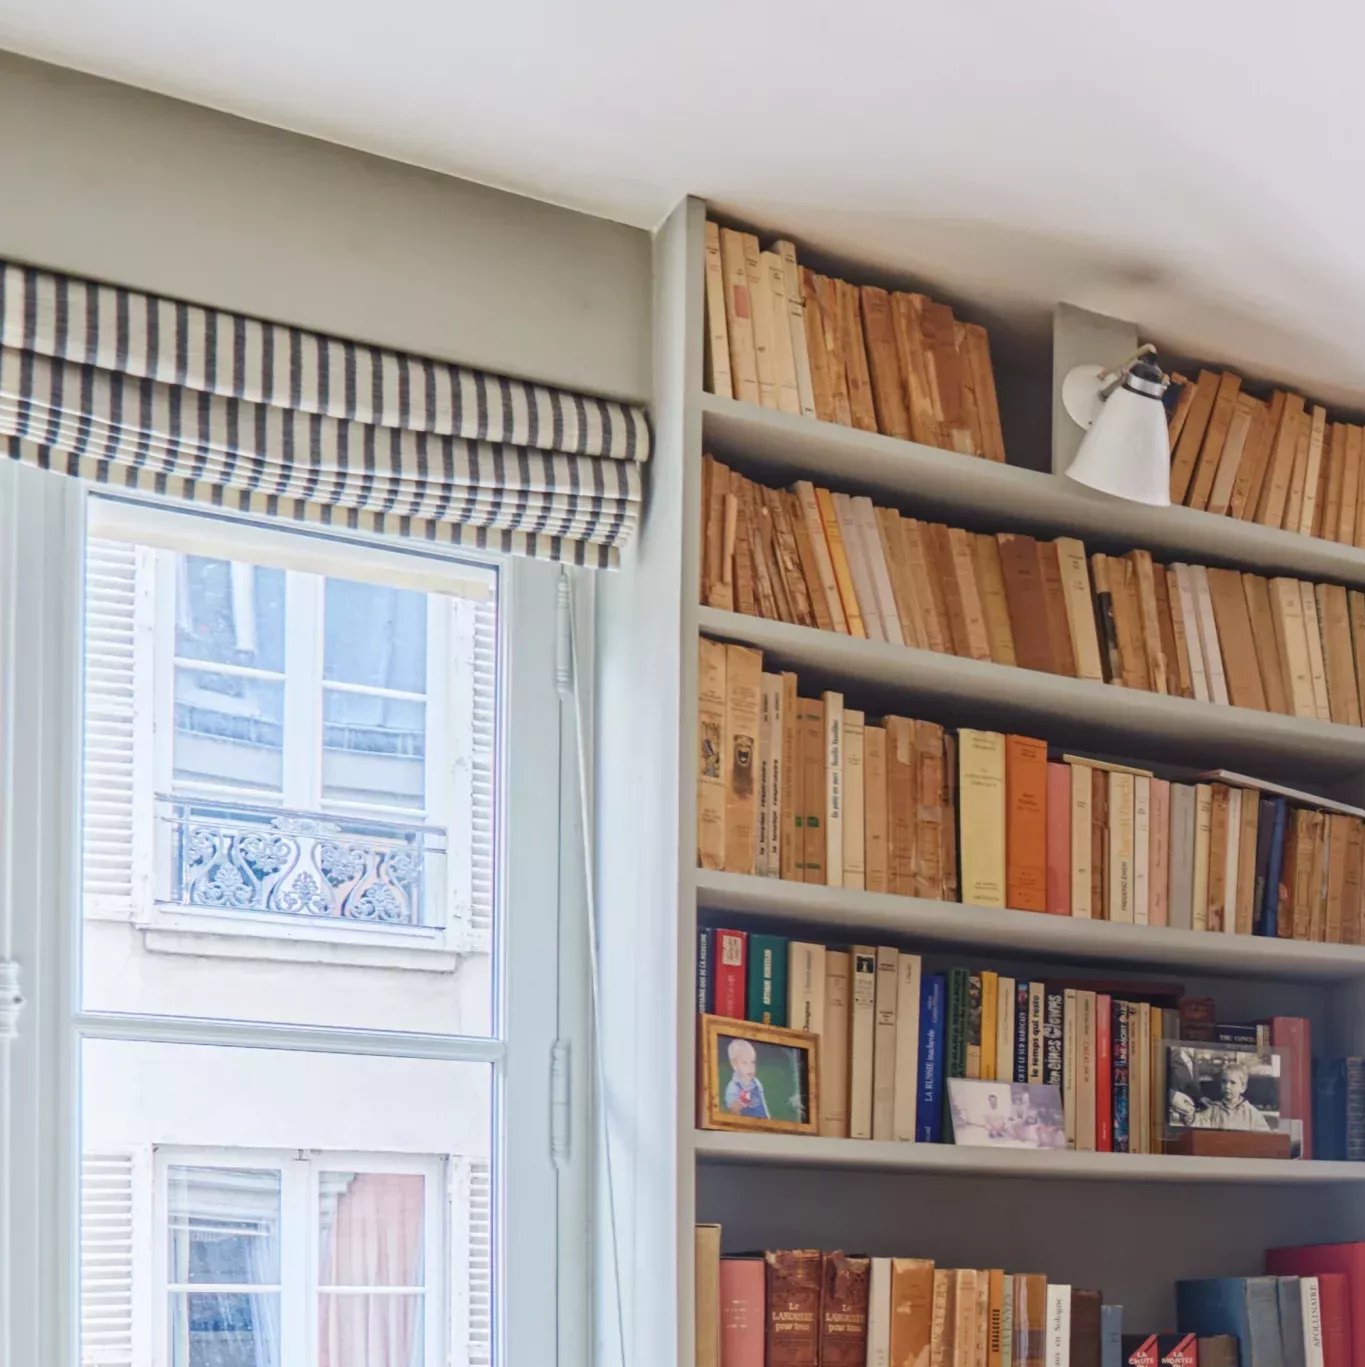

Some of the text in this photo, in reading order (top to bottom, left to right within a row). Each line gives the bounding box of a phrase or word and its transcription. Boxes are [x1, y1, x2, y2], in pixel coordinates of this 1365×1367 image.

[1030, 995, 1041, 1078] le temps qui reste
[1043, 994, 1062, 1070] eines Clowns
[925, 1062, 934, 1089] RUSSIE
[925, 1091, 933, 1102] LA
[1053, 1298, 1064, 1332] Sologne
[1309, 1284, 1321, 1348] APOLLINAIRE
[1054, 1336, 1061, 1347] en
[1128, 1357, 1154, 1365] CHUTE
